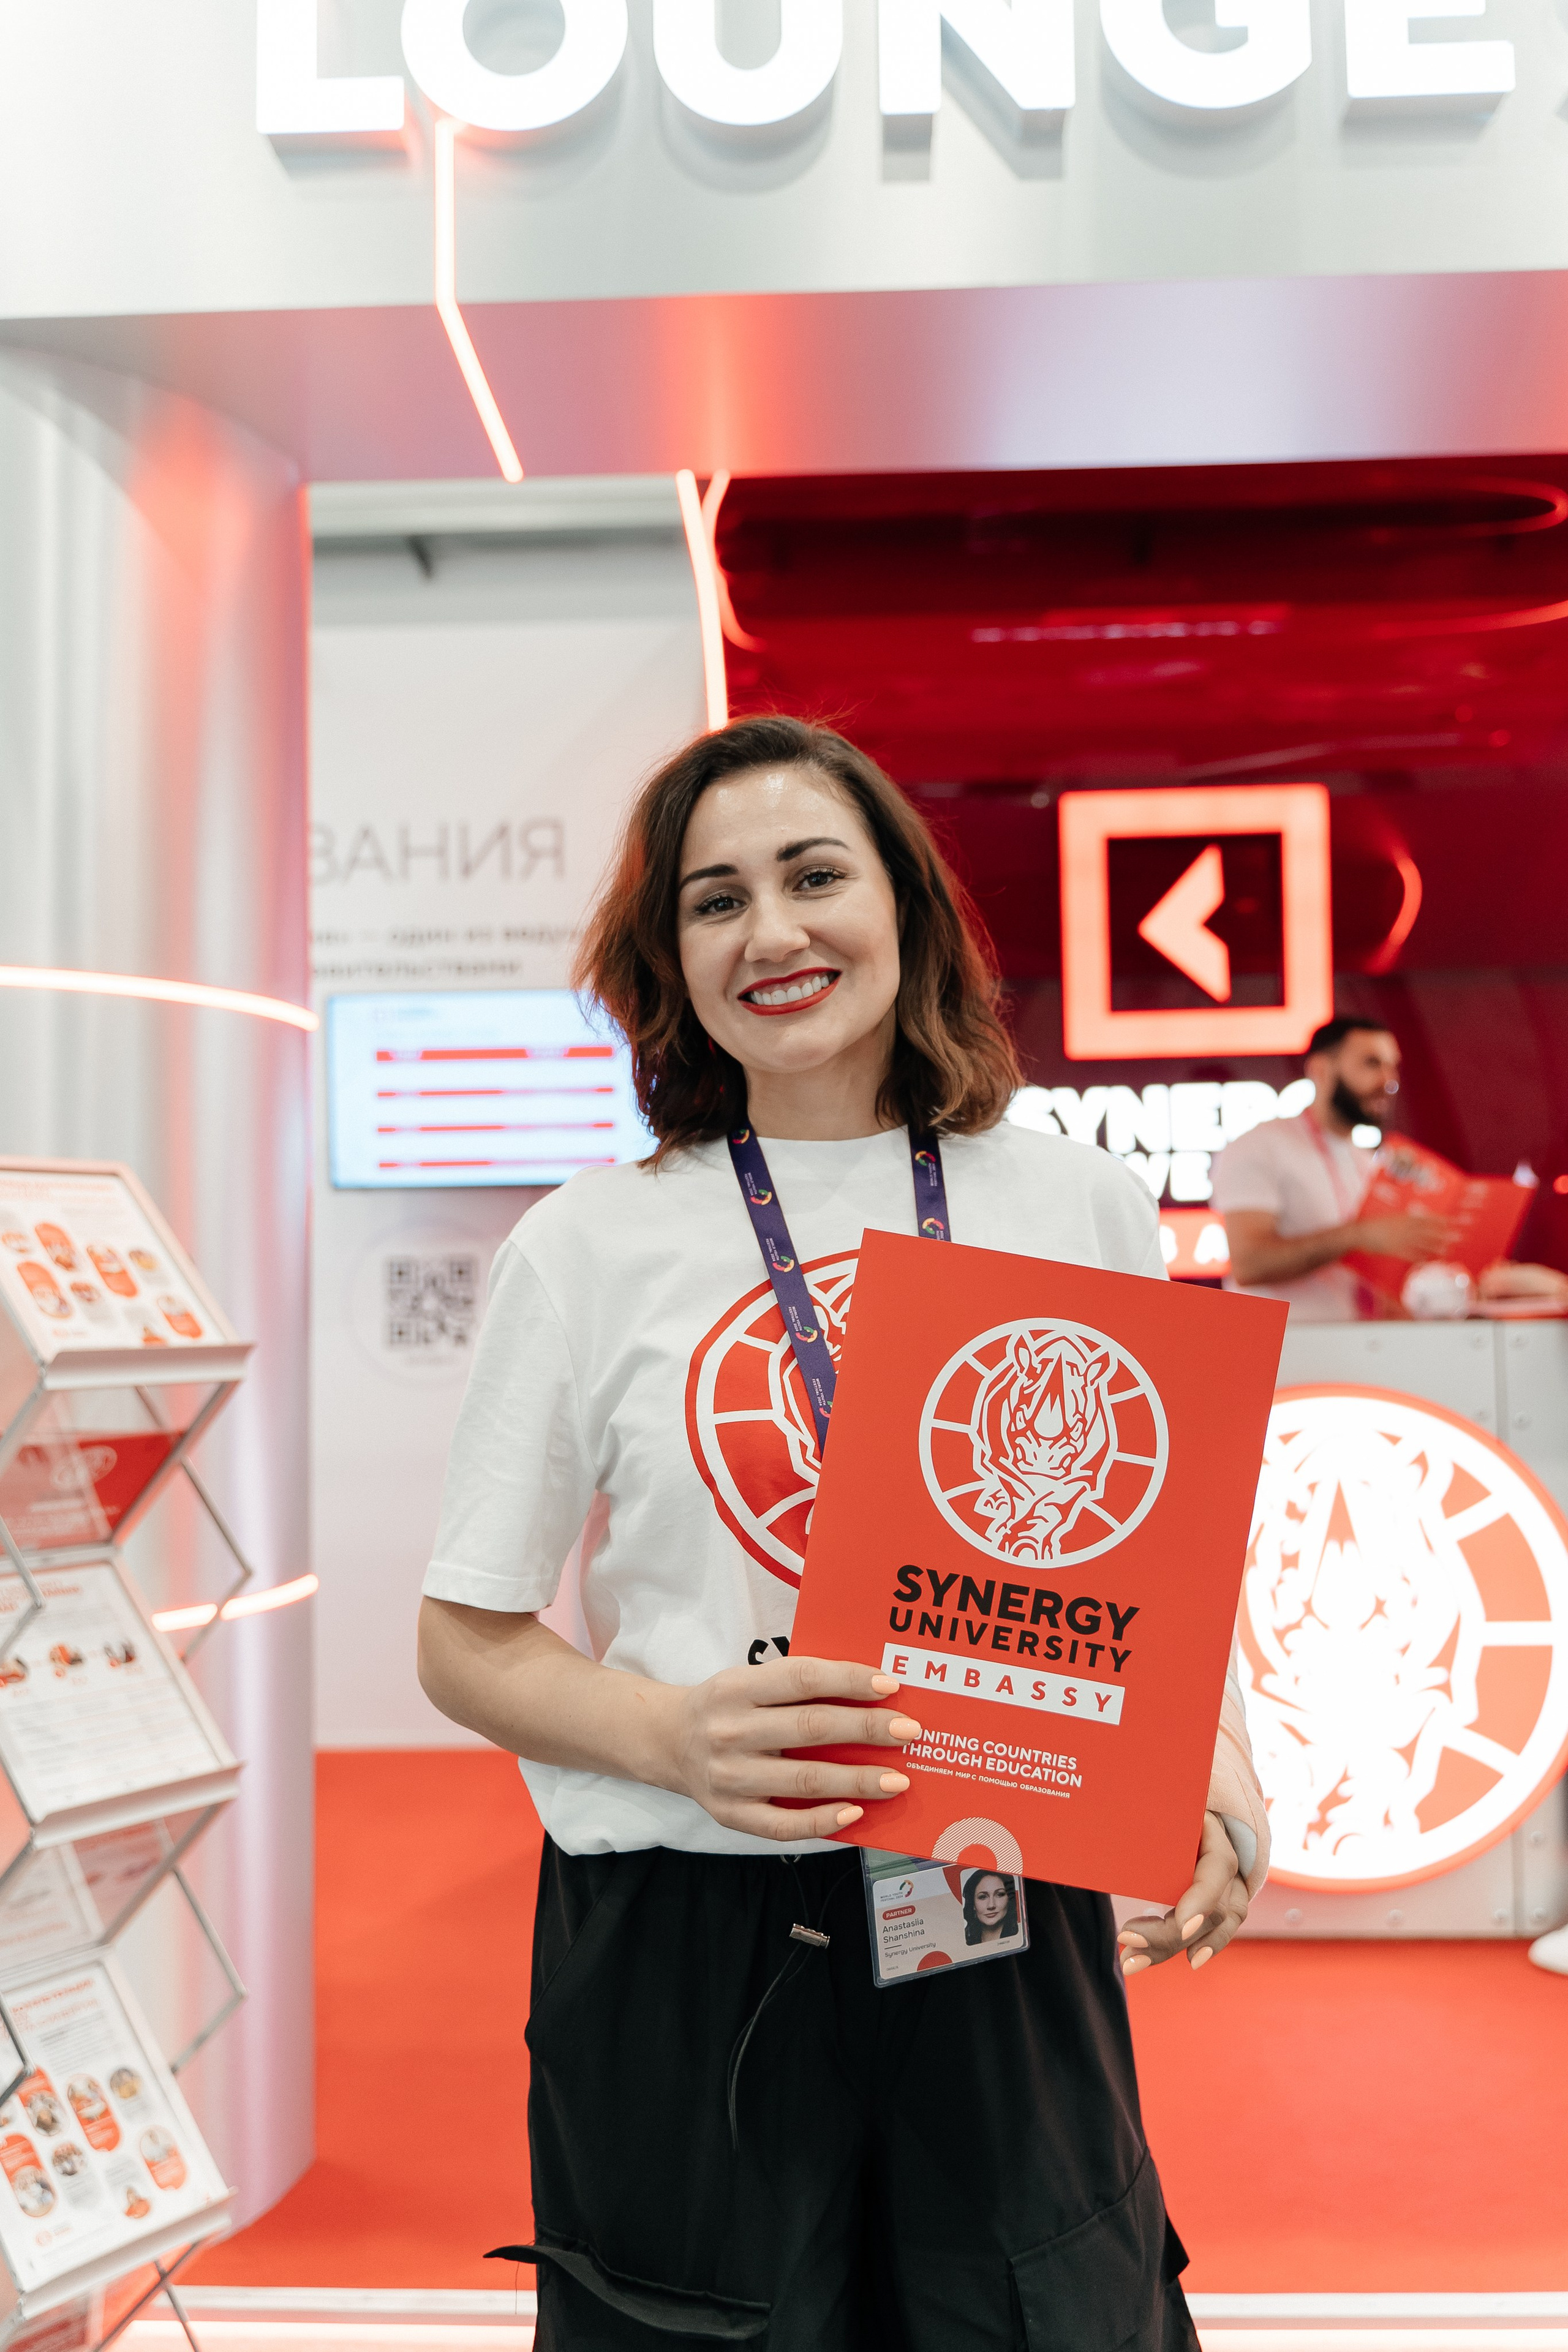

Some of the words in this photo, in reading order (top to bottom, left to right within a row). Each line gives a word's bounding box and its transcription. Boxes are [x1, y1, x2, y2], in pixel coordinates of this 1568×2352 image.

[892, 1564, 1140, 1642] SYNERGY
[889, 1606, 1132, 1673] UNIVERSITY
[892, 1654, 1112, 1713] EMBASSY
[982, 1741, 1077, 1770] COUNTRIES
[906, 1762, 953, 1776] ОБЪЕДИНЯЕМ
[955, 1771, 971, 1779] МИР
[978, 1775, 1018, 1788] ПОМОЩЬЮ
[1019, 1783, 1071, 1798] ОБРАЗОВАНИЯ
[986, 1757, 1082, 1788] EDUCATION
[883, 1918, 924, 1933] Anastasiia
[886, 1908, 912, 1918] PARTNER
[883, 1929, 925, 1943] Shanshina
[884, 1949, 908, 1958] Synergy
[909, 1942, 937, 1952] University
